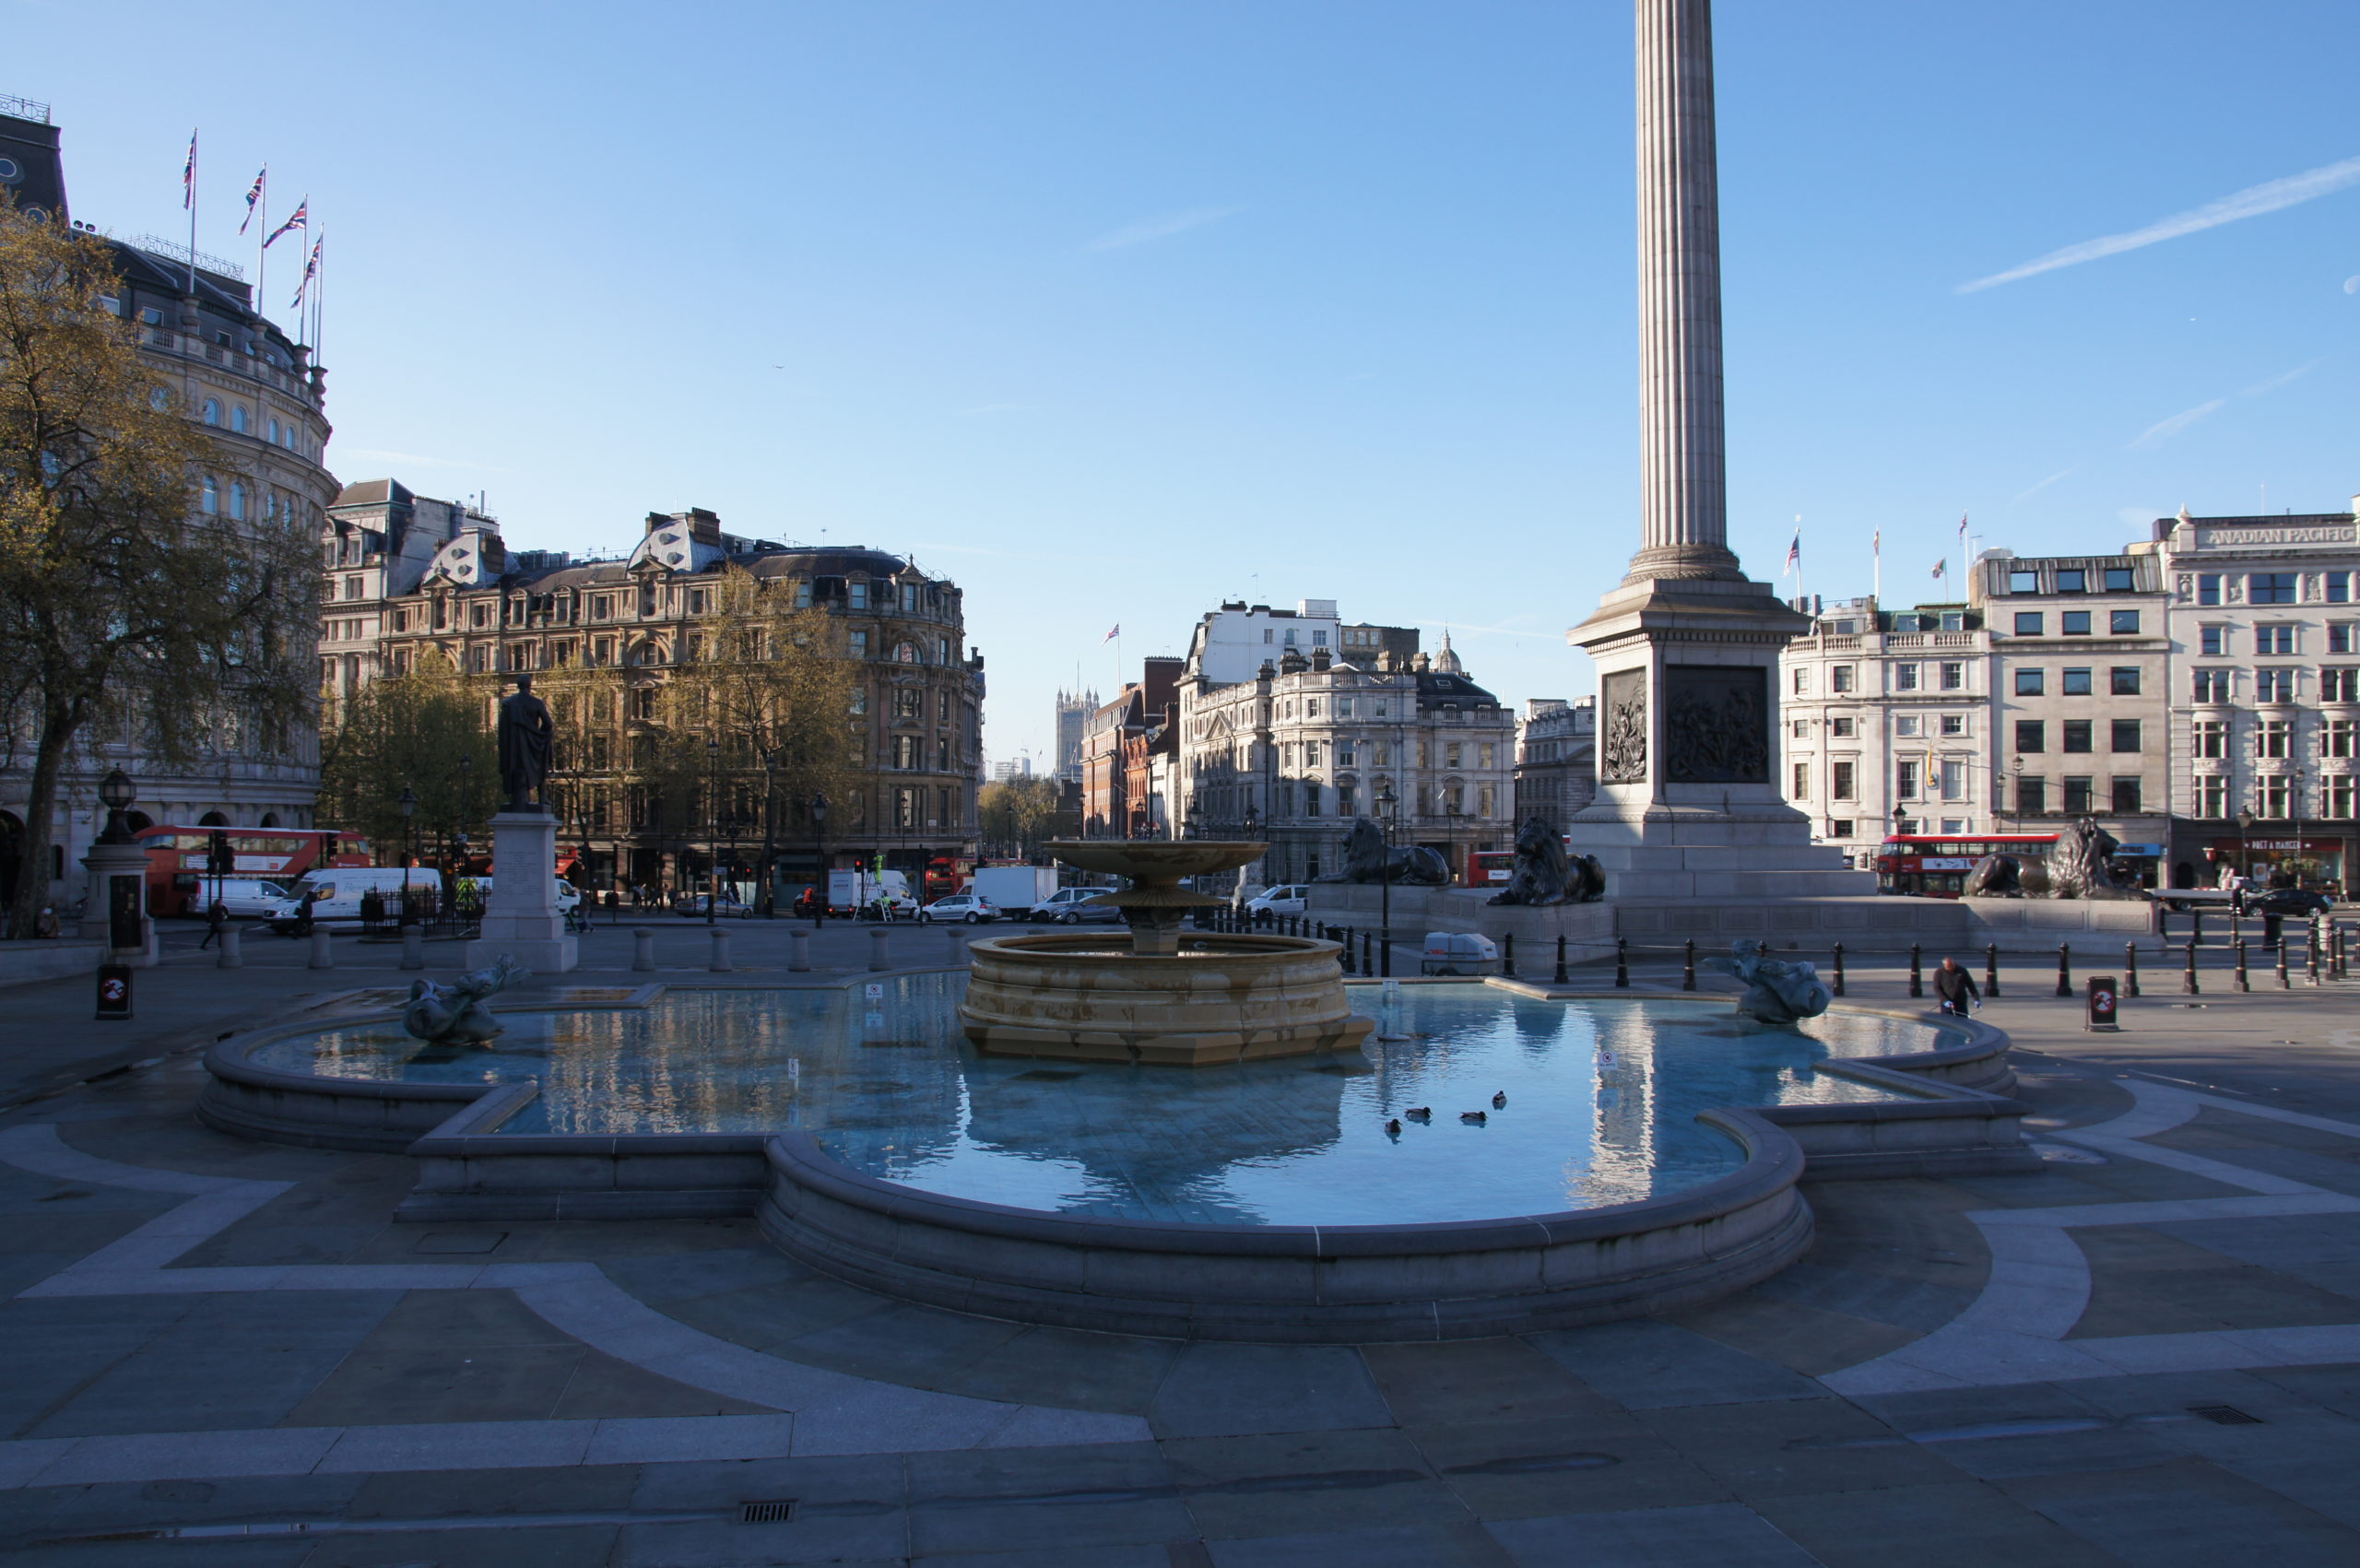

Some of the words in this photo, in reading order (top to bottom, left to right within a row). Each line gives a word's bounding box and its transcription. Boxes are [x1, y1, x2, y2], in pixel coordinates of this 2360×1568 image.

[2207, 530, 2281, 544] ANADIAN
[2288, 528, 2354, 543] PACIFIC
[2252, 841, 2267, 849] PRET
[2269, 841, 2274, 849] A
[2275, 841, 2301, 849] MANGER
